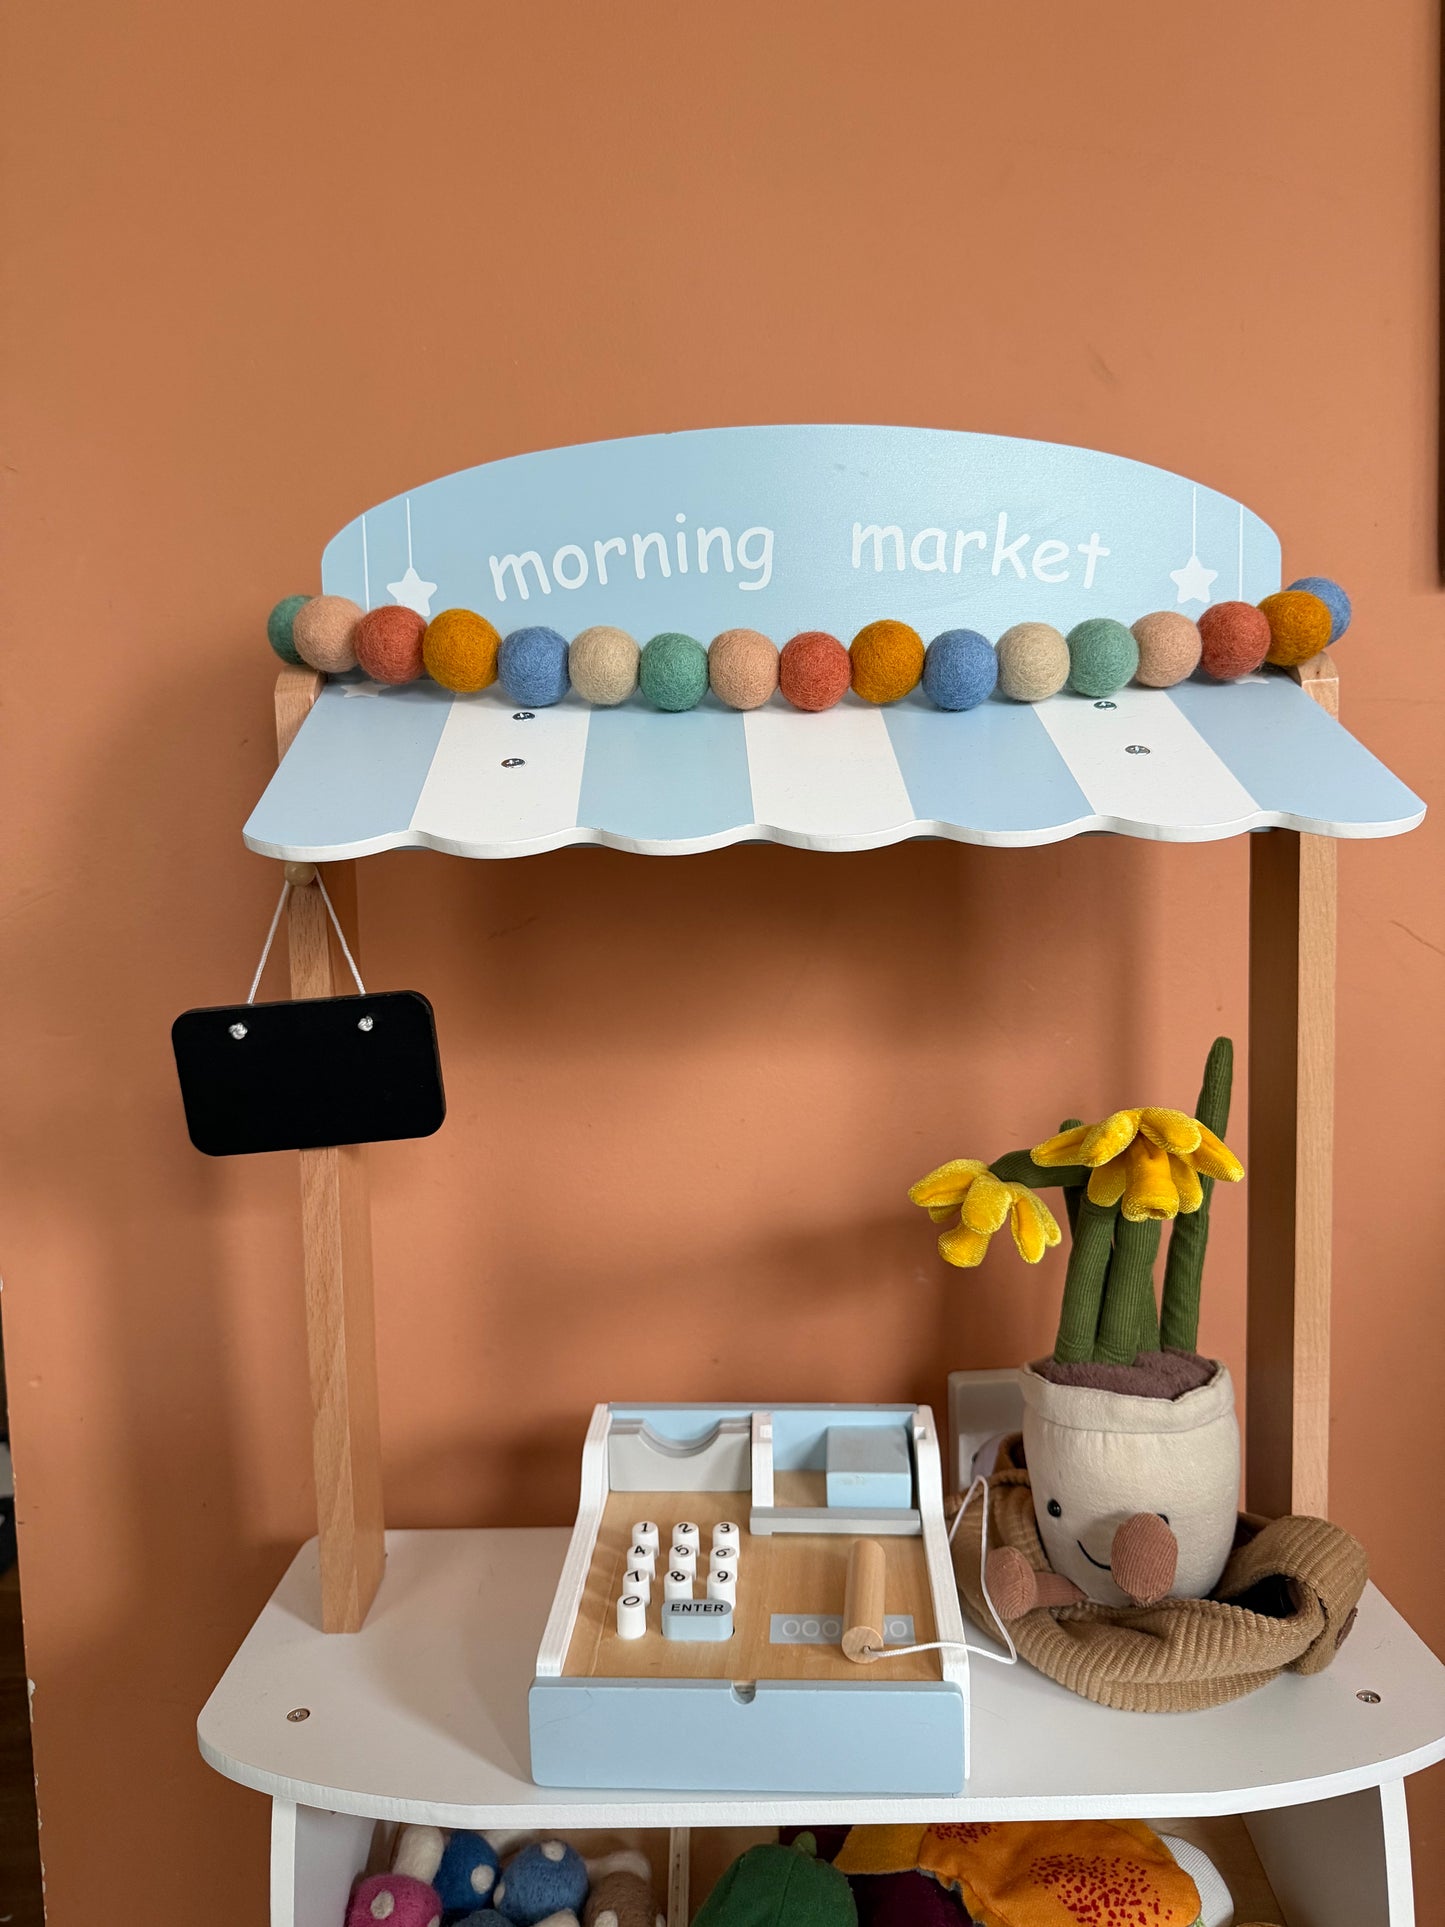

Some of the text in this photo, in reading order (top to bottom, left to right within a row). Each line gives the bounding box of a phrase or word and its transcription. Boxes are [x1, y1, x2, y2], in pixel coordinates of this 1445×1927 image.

[489, 511, 1111, 601] morning market
[641, 1522, 731, 1533] 1 2 3
[634, 1545, 730, 1557] 4 5 6
[627, 1571, 729, 1582] 7 8 9
[670, 1604, 724, 1612] ENTER
